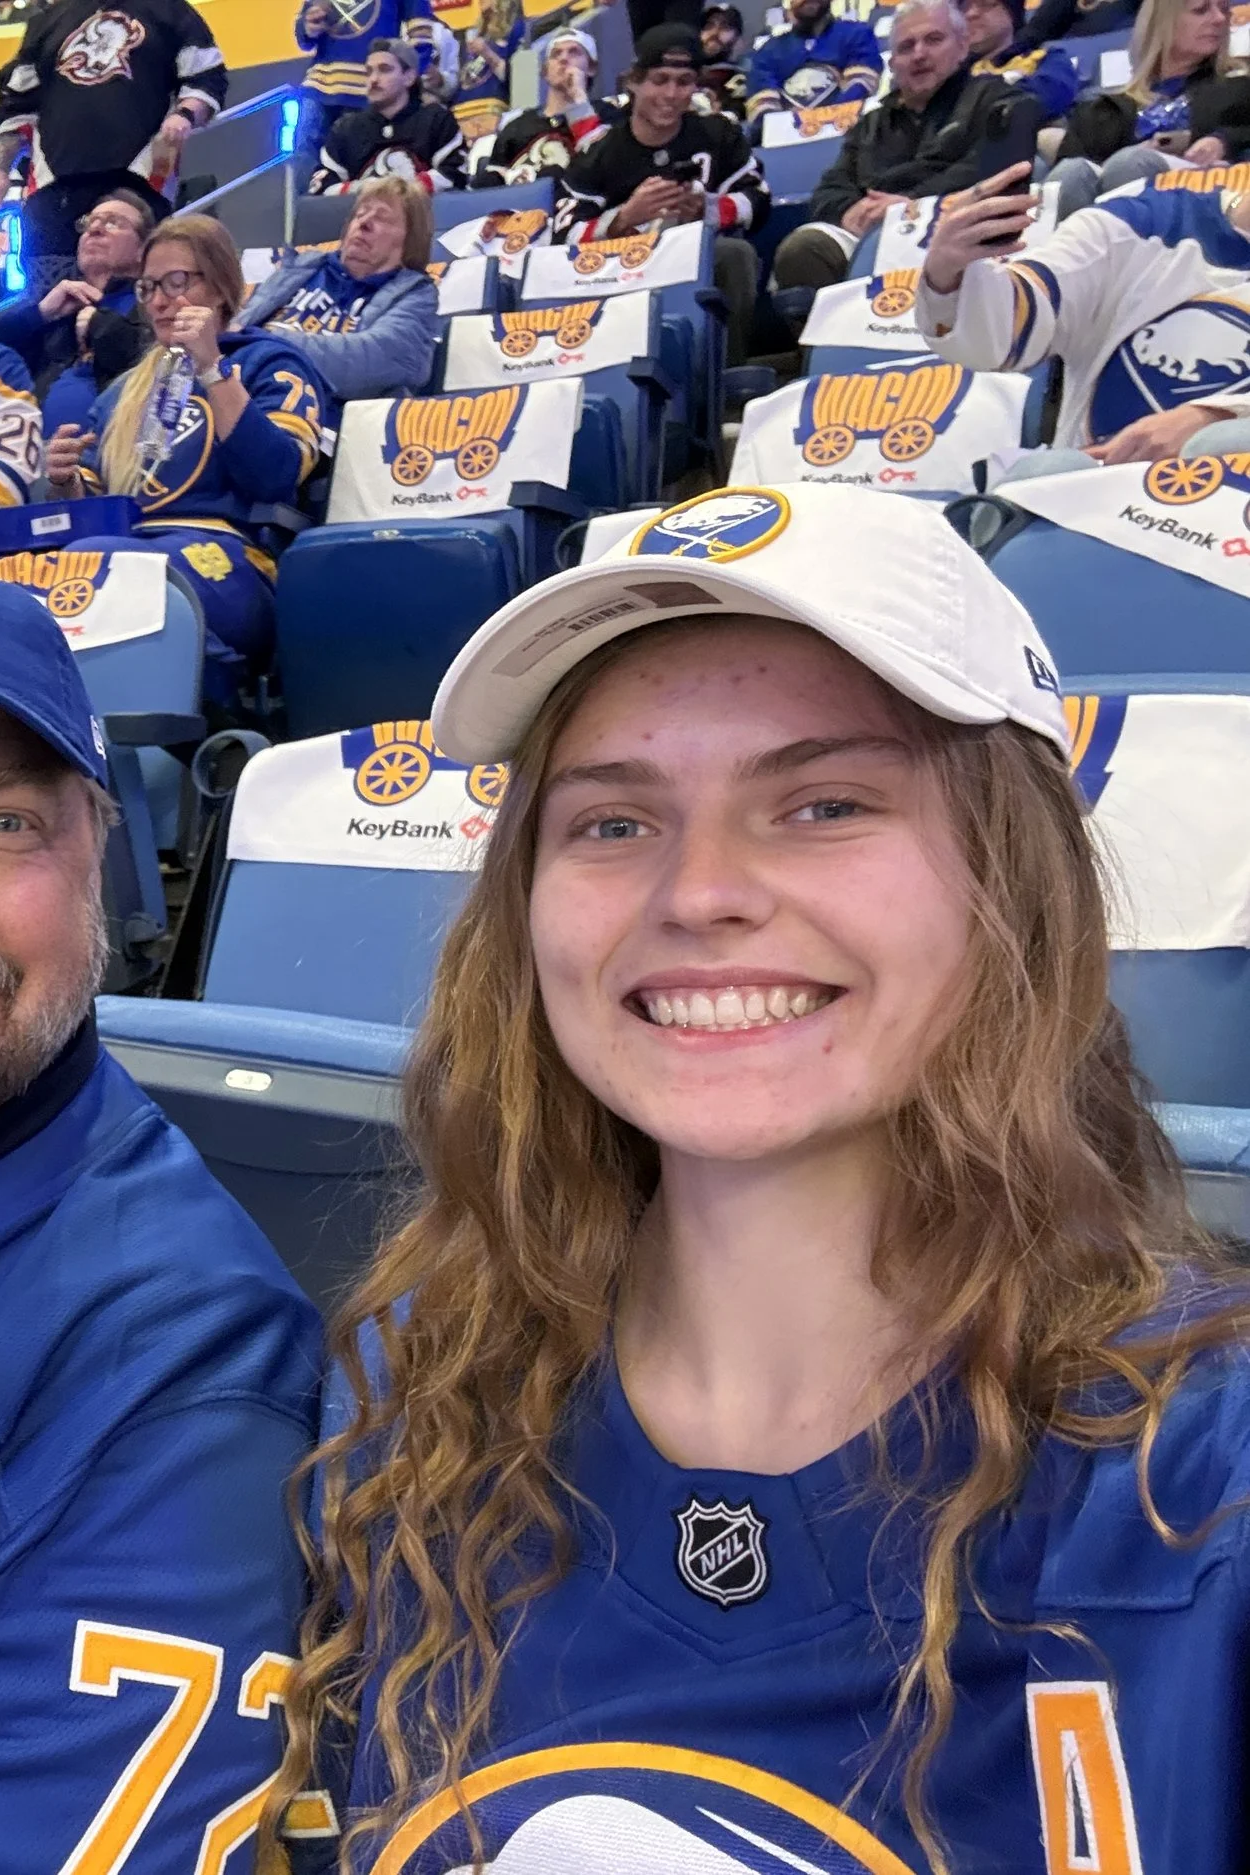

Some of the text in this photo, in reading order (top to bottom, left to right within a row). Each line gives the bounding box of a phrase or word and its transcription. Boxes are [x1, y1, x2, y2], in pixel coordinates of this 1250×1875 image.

[395, 384, 520, 453] WAGON
[812, 363, 964, 433] WAGON
[390, 490, 453, 507] KeyBank
[1118, 503, 1220, 552] KeyBank
[346, 817, 454, 842] KeyBank
[699, 1531, 745, 1577] NHL
[1025, 1680, 1144, 1875] A
